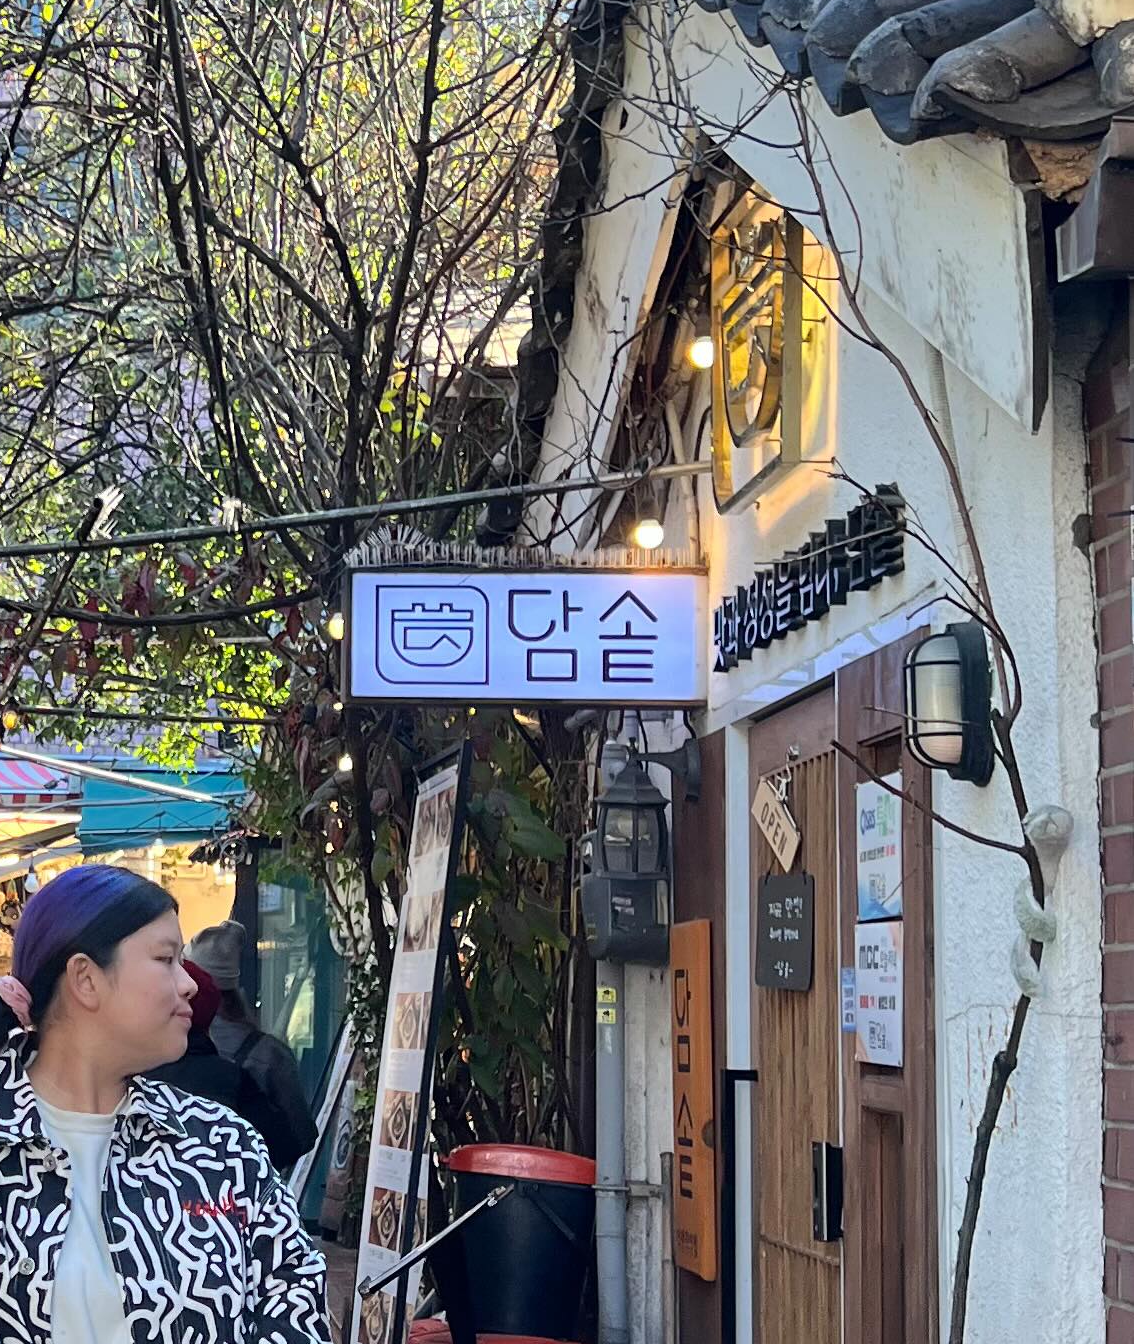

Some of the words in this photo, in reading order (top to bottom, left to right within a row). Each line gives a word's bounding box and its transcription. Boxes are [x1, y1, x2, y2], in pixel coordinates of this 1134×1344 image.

[508, 589, 658, 683] 담솥
[760, 802, 788, 856] OPEN
[674, 968, 694, 1200] 담솥
